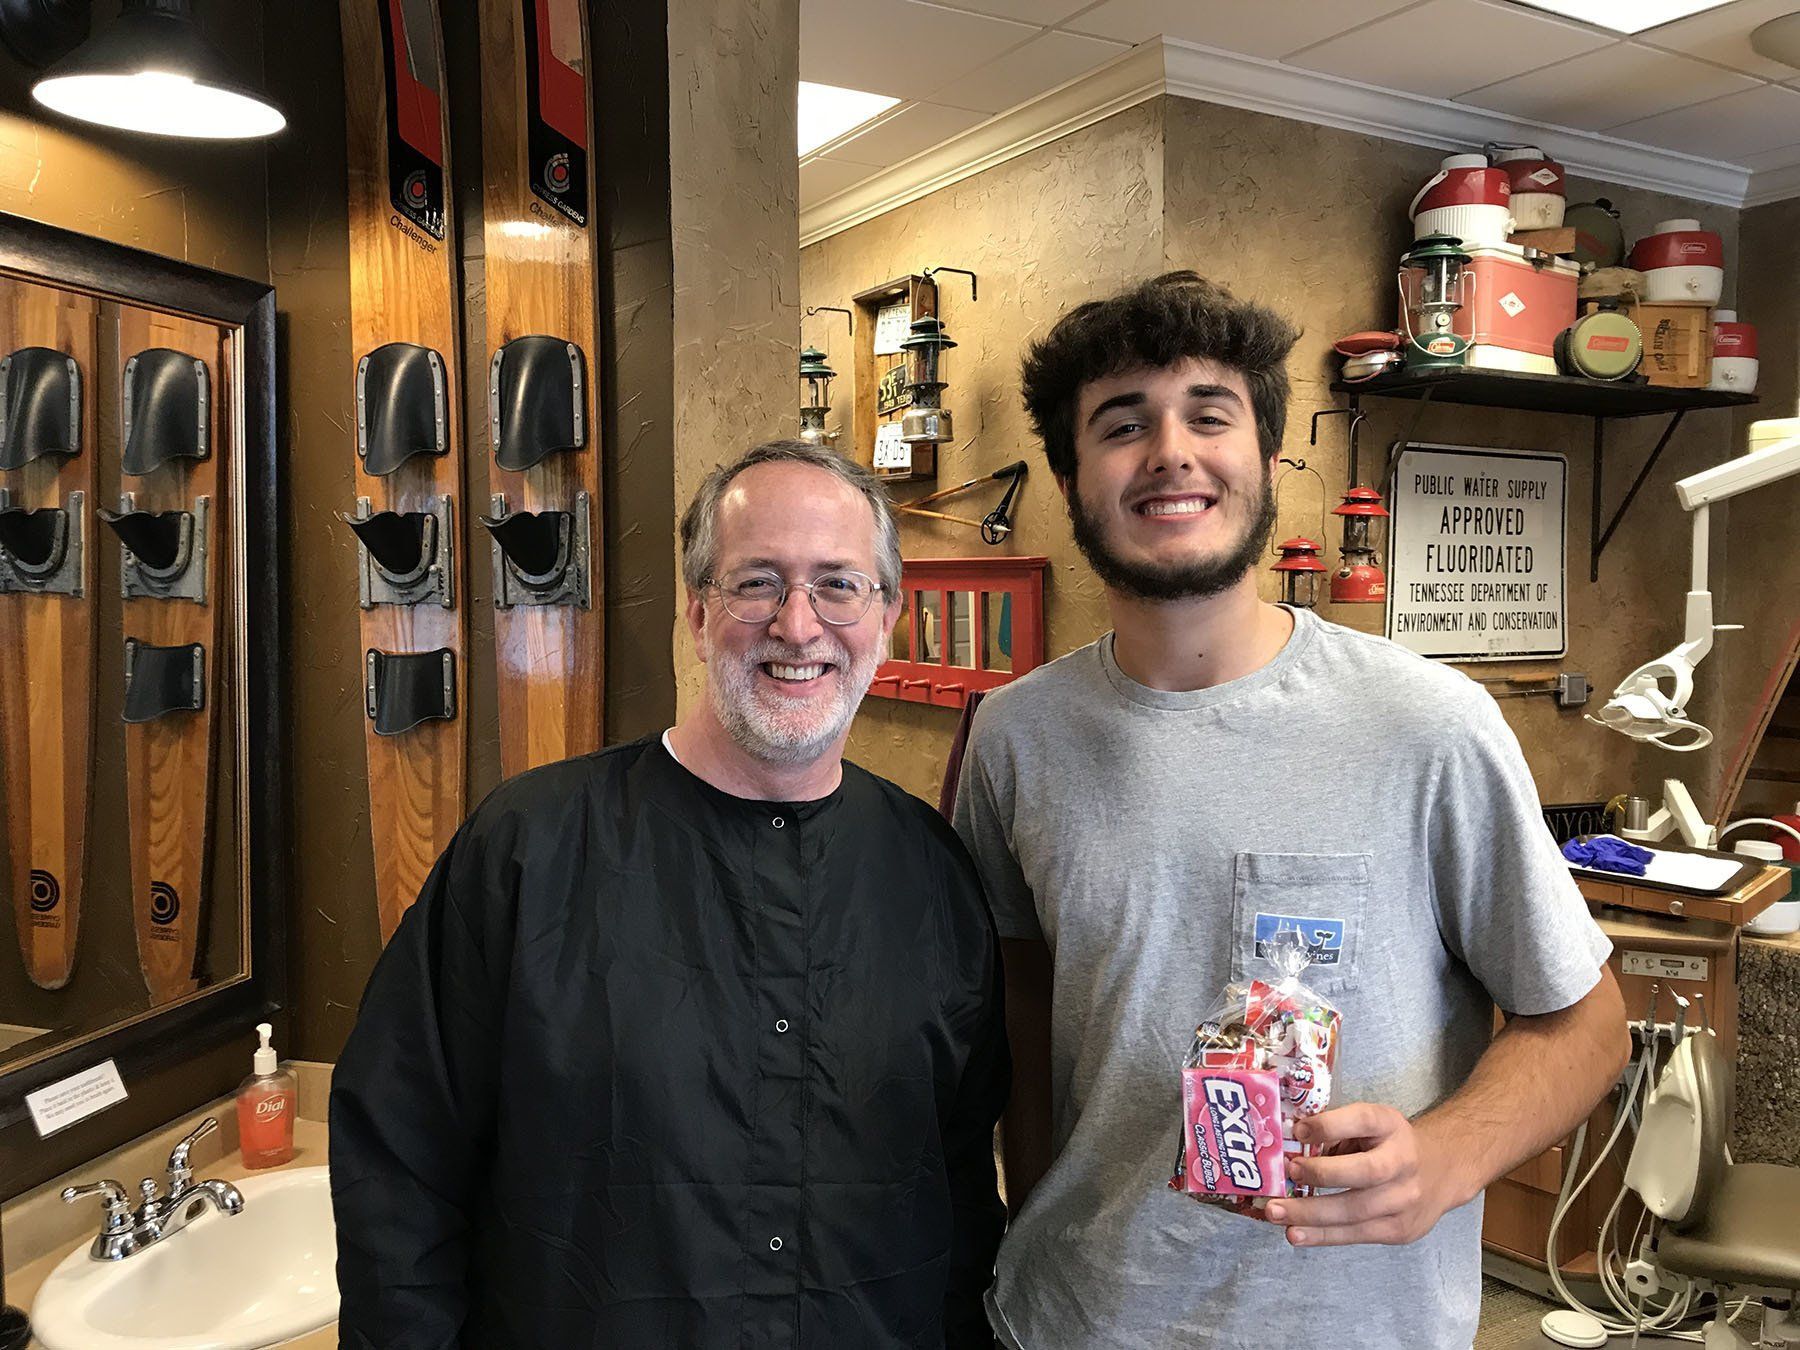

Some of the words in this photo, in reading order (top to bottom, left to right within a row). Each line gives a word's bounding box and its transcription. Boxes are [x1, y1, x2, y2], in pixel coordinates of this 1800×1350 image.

[557, 201, 585, 224] GARDENS
[390, 215, 438, 255] Challenger
[1415, 474, 1454, 496] PUBLIC
[1464, 477, 1499, 498] WATER
[1508, 480, 1547, 500] SUPPLY
[1440, 506, 1524, 535] APPROVED
[1426, 544, 1533, 573] FLUORIDATED
[1410, 583, 1465, 602] TENNESSEE
[1471, 583, 1531, 602] DEPARTMENT
[1536, 584, 1548, 601] OF
[1397, 612, 1463, 633] ENVIRONMENT
[1468, 612, 1487, 631] AND
[1492, 611, 1558, 631] CONSERVATION
[256, 1098, 285, 1114] Dial
[1202, 1077, 1262, 1191] Extra
[1214, 1124, 1225, 1150] LASTING
[1195, 1124, 1209, 1158] CLASSIC
[1202, 1158, 1216, 1191] BUBBLE
